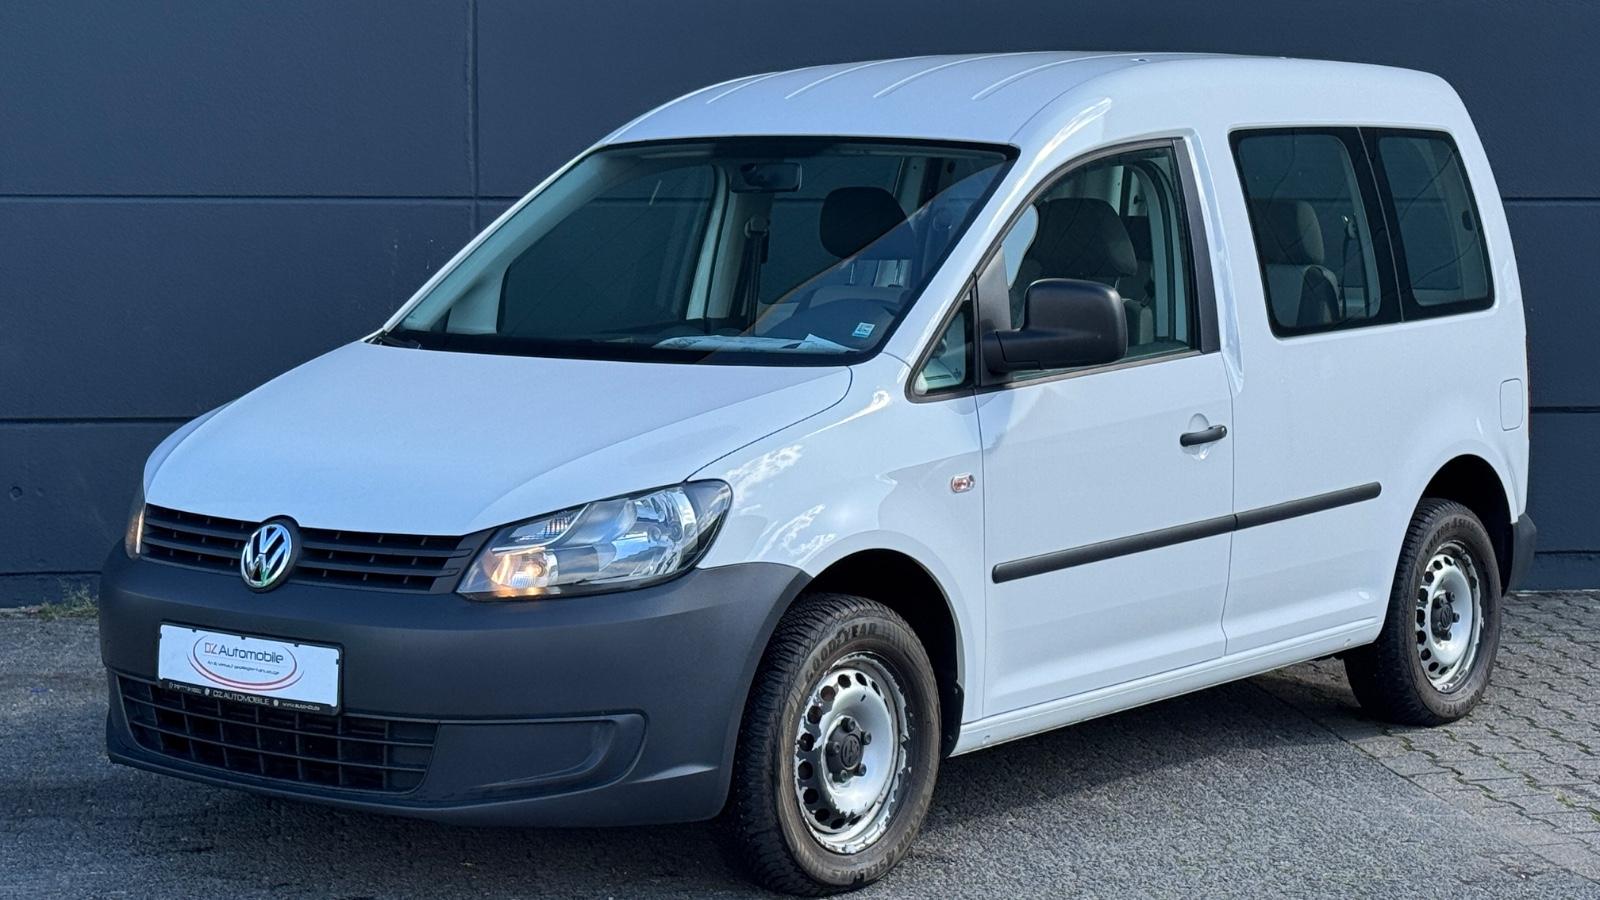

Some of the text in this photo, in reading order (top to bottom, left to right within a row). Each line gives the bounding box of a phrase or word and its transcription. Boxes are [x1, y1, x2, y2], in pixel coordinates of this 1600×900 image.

[218, 644, 284, 664] Automobile
[805, 622, 878, 682] GOODYEAR
[223, 691, 270, 706] AUTOMOBILE
